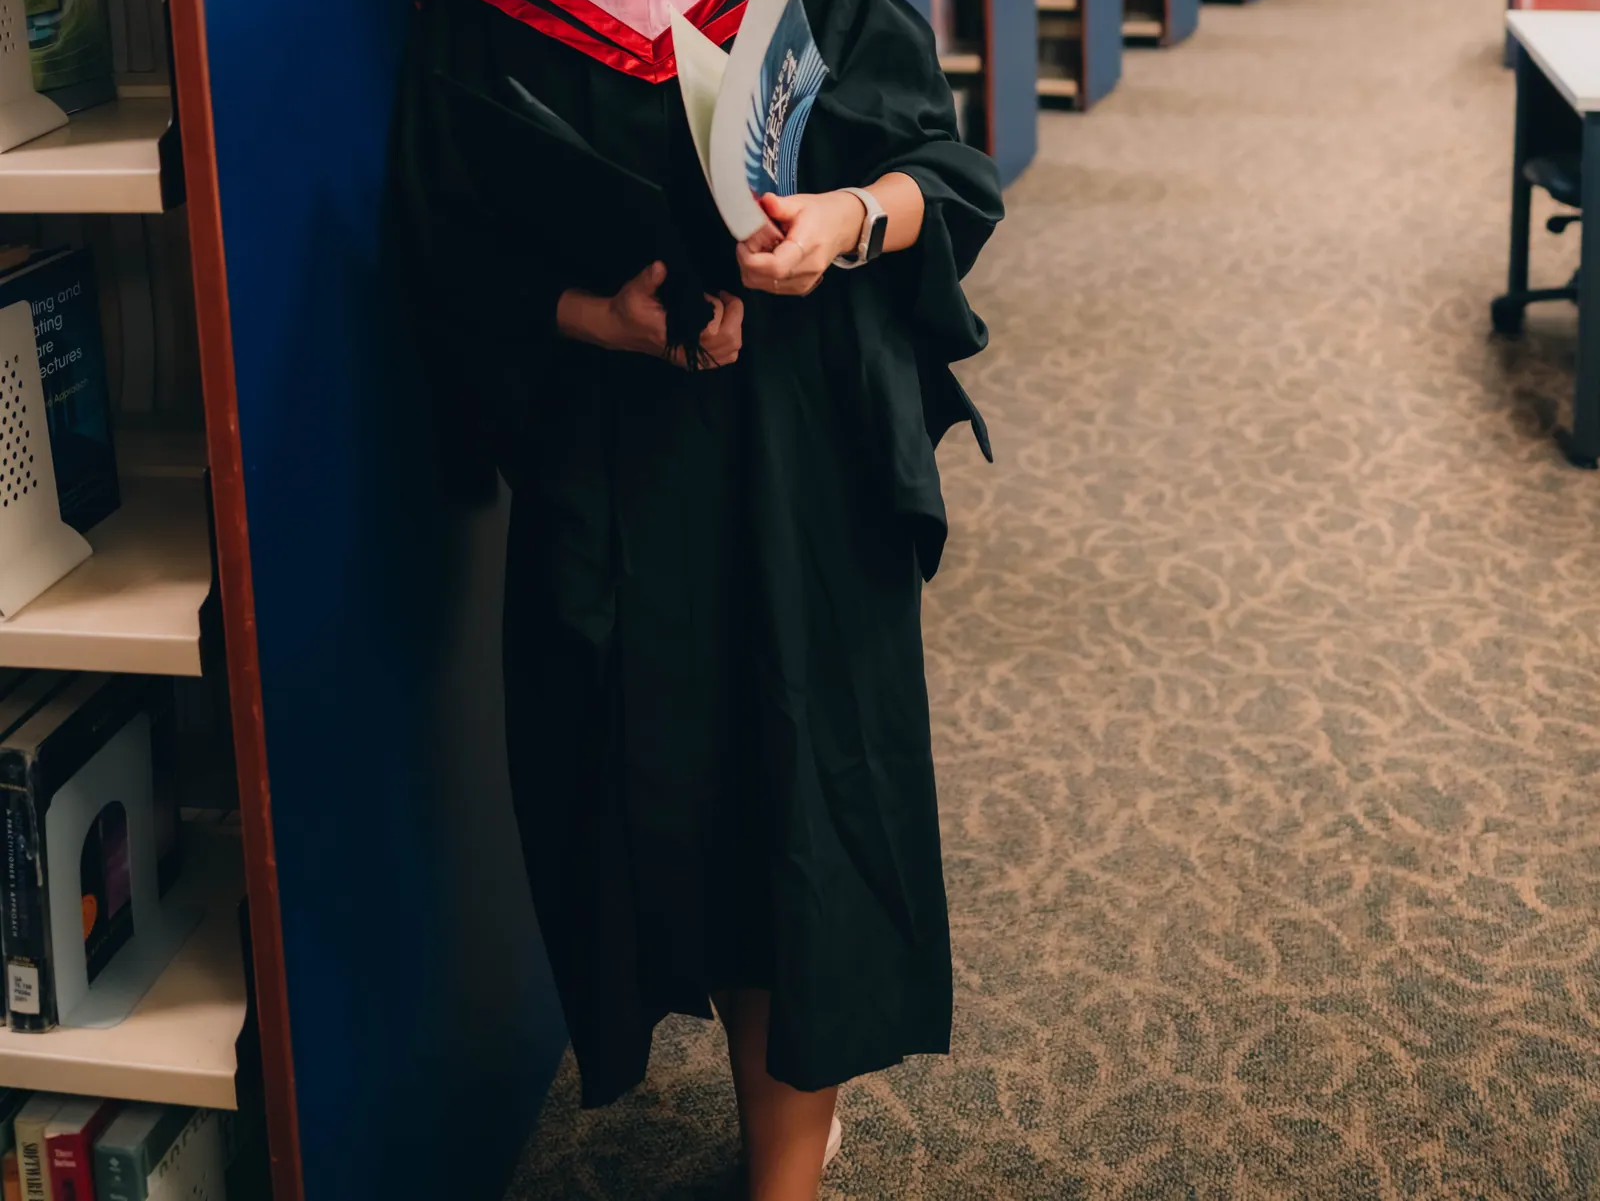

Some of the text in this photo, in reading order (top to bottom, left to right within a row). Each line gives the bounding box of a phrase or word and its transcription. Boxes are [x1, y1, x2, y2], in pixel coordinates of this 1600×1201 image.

[765, 85, 787, 182] FLEX
[57, 280, 82, 303] and
[54, 377, 89, 402] Approach
[9, 891, 18, 938] APPROACH
[22, 1142, 45, 1196] SOFTWARE
